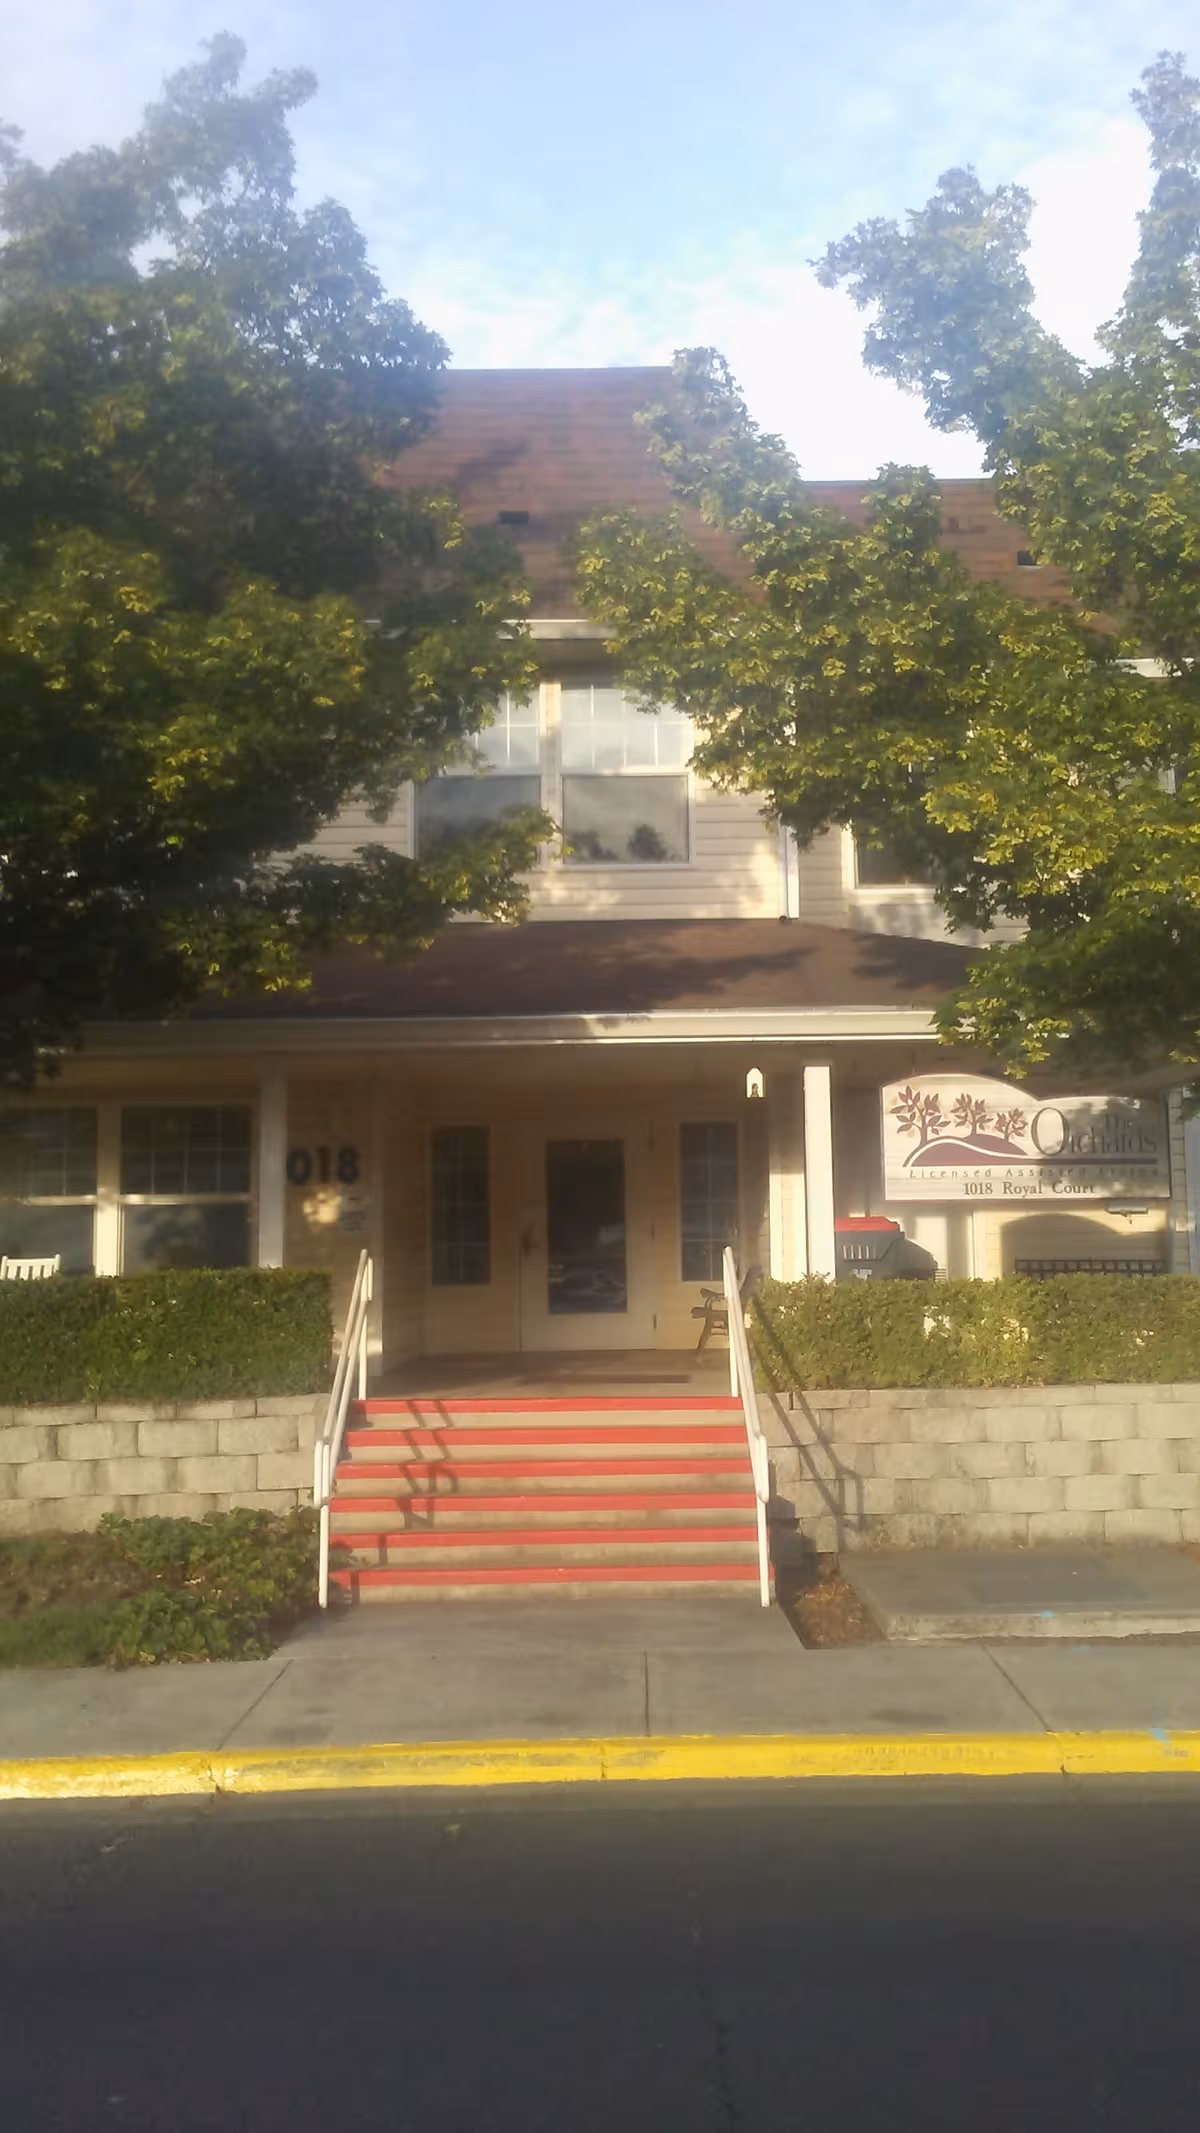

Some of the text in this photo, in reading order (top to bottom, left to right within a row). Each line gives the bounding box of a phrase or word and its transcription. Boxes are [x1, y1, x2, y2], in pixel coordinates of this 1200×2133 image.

[909, 1168, 992, 1179] Licensed
[963, 1181, 1096, 1198] 1018 Royal Court
